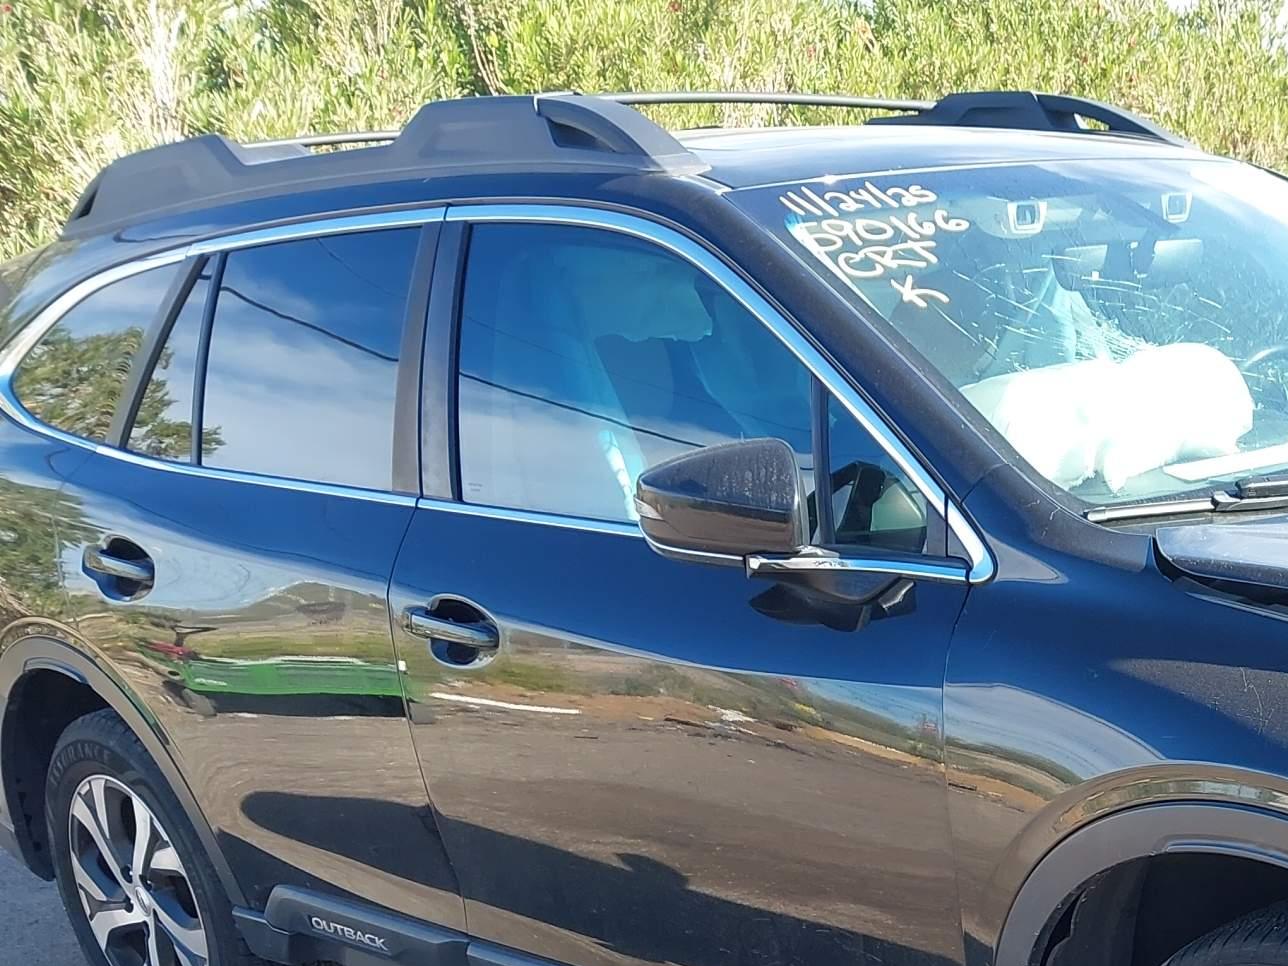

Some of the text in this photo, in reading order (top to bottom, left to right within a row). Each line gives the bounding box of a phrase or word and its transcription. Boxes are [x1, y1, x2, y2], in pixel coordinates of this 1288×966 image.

[779, 181, 938, 217] 11/24/25
[837, 239, 938, 278] CRT
[311, 916, 389, 951] OUTBACK
